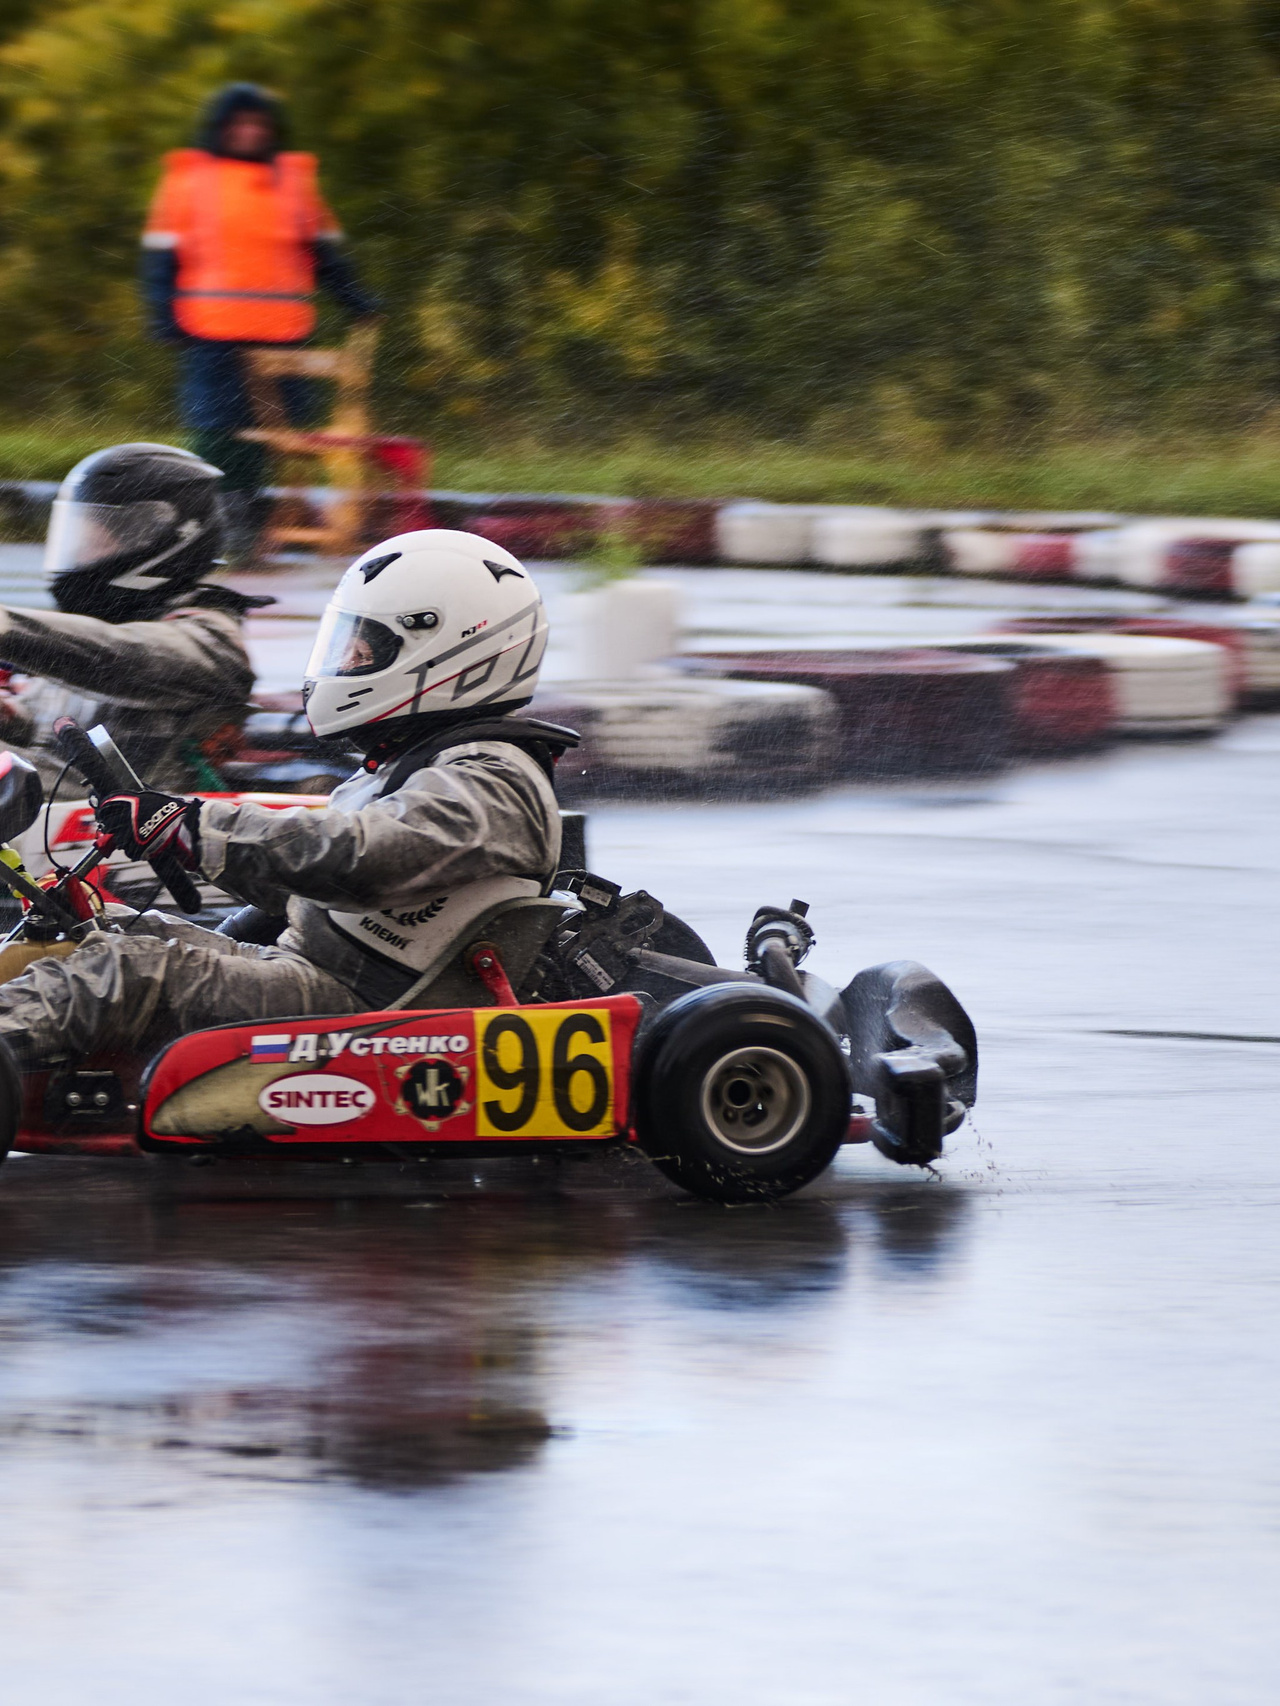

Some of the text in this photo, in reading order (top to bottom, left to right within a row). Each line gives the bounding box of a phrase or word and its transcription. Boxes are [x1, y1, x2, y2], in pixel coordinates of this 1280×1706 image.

[139, 801, 179, 837] sparco
[288, 1032, 470, 1063] Д.Устенко
[483, 1013, 609, 1132] 96
[268, 1090, 366, 1108] SINTEC
